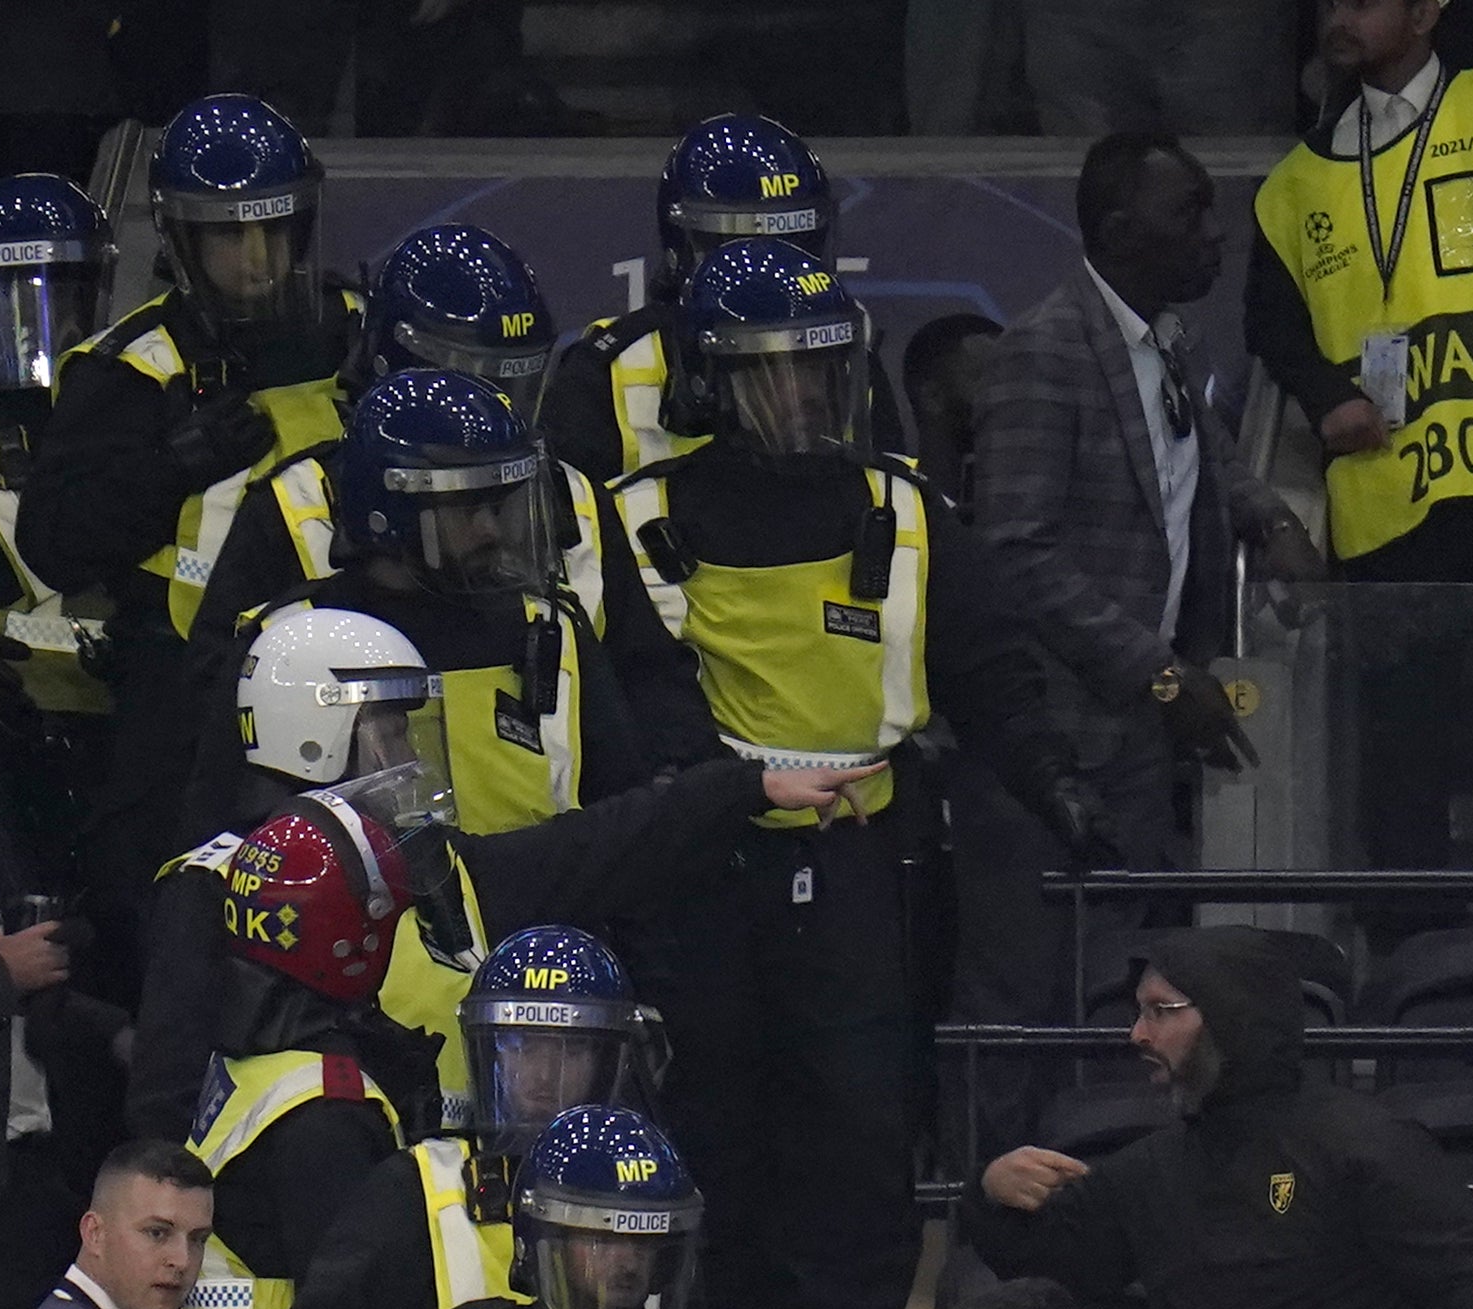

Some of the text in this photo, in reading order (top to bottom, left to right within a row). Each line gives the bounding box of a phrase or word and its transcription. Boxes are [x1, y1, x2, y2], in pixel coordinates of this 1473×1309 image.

[759, 174, 801, 198] MP
[240, 198, 292, 219] POLICE
[766, 212, 816, 232] POLICE
[796, 271, 833, 297] MP
[500, 312, 536, 339] MP
[807, 326, 852, 346] POLICE
[231, 873, 262, 898] MP
[522, 967, 570, 990] MP
[514, 1004, 569, 1024] POLICE
[614, 1158, 658, 1183] MP
[616, 1212, 668, 1232] POLICE
